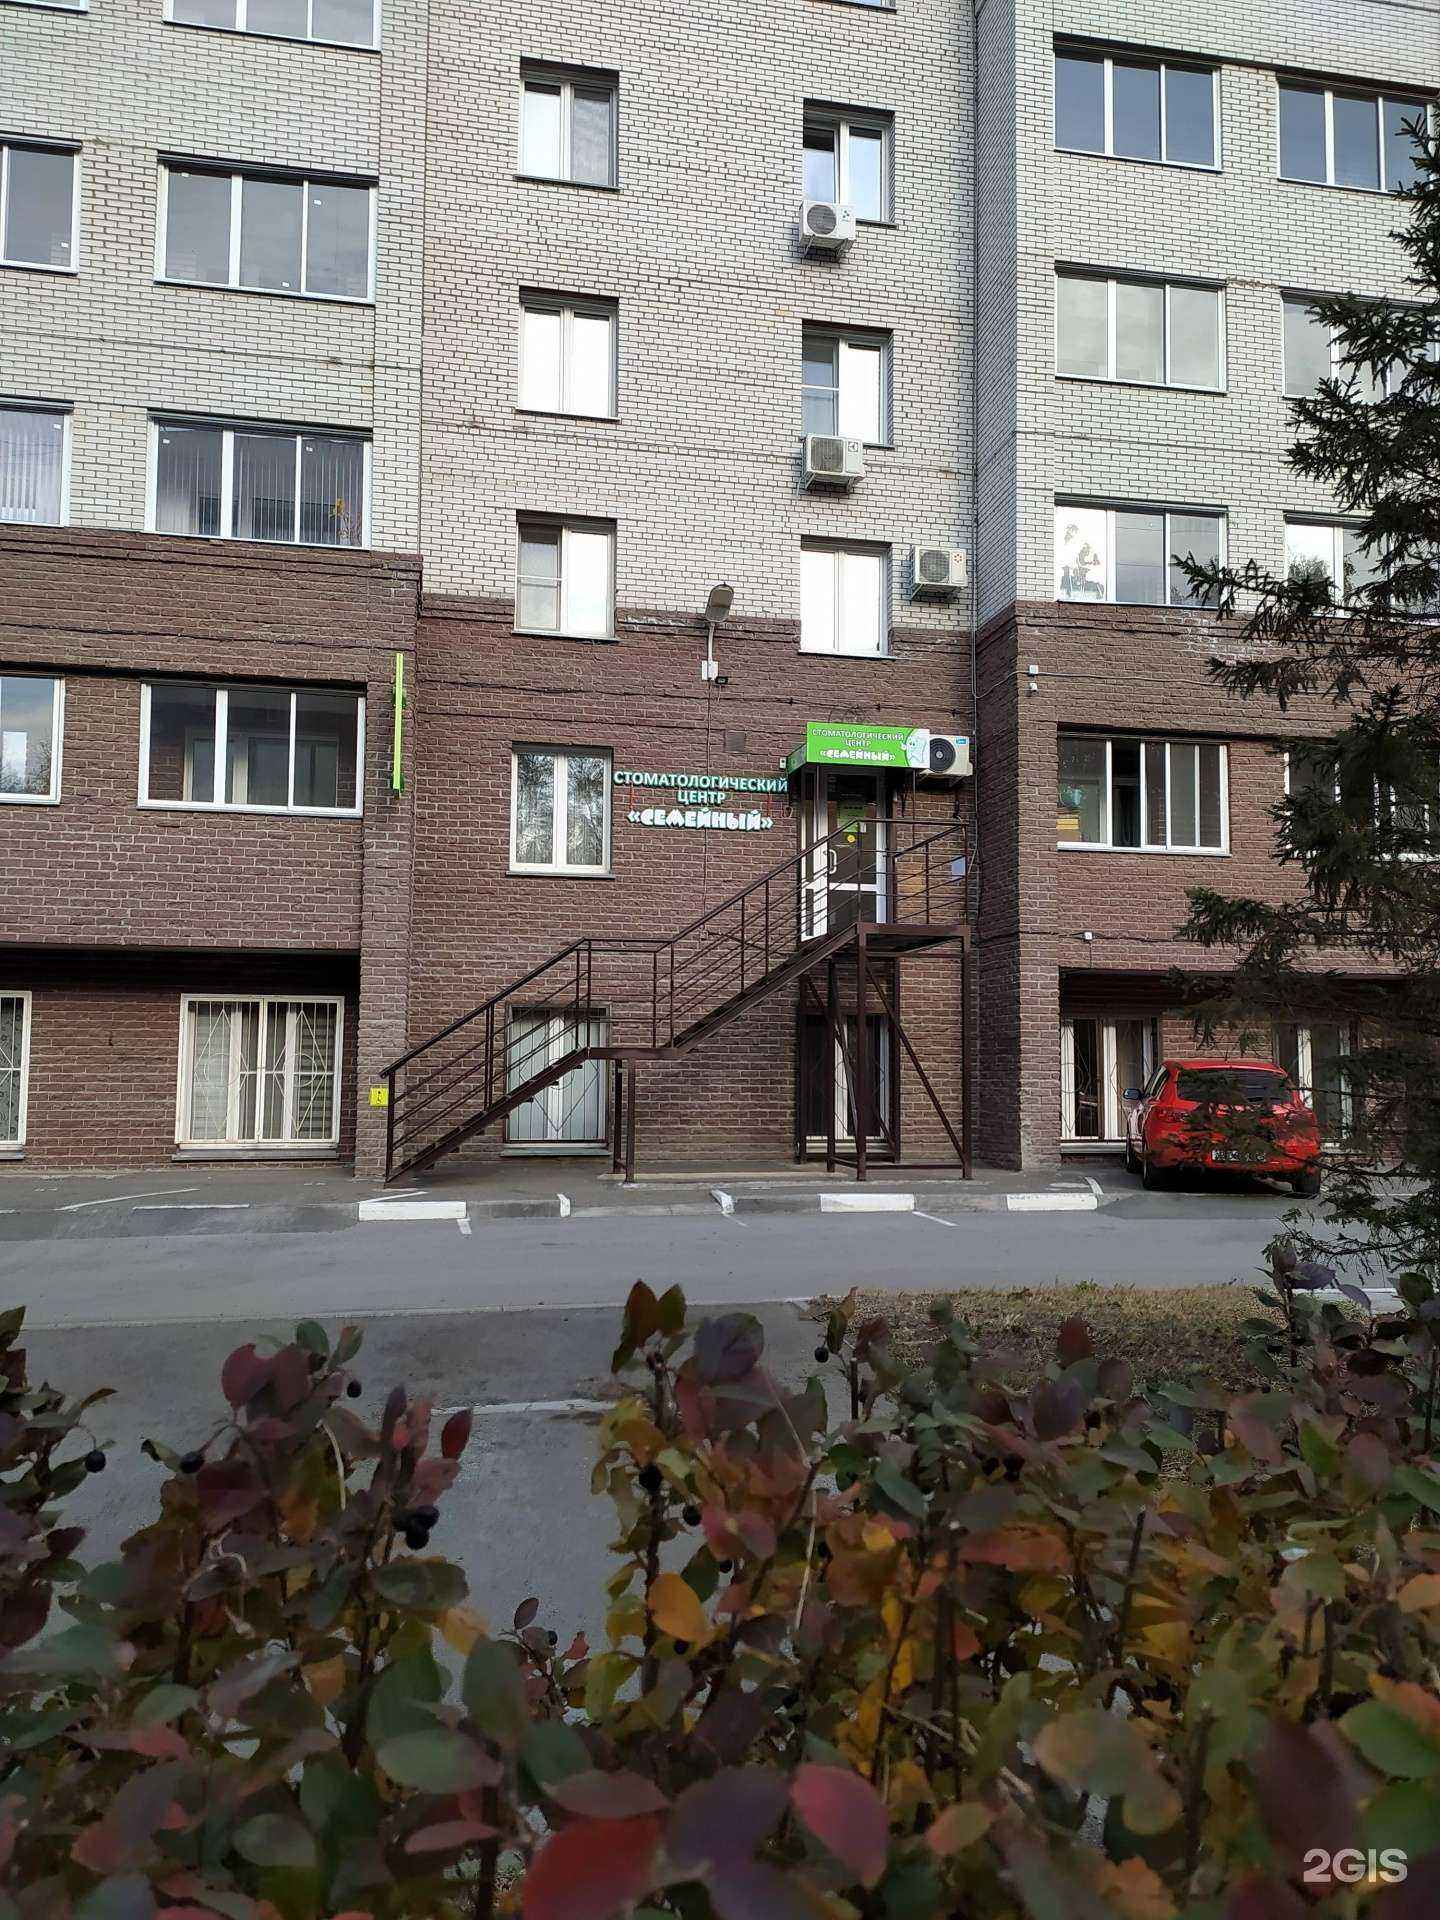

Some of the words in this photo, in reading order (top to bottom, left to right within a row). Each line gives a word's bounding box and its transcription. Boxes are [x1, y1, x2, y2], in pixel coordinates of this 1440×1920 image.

[812, 729, 905, 741] СТОМАТОЛОГИЧЕСКИЙ
[844, 739, 871, 747] ЦЕНТР
[613, 771, 788, 793] СТОМАТОЛОГИЧЕСКИЙ
[677, 790, 727, 806] ЦЕНТР
[627, 808, 774, 831] «СЕМЕЙНЫЙ»
